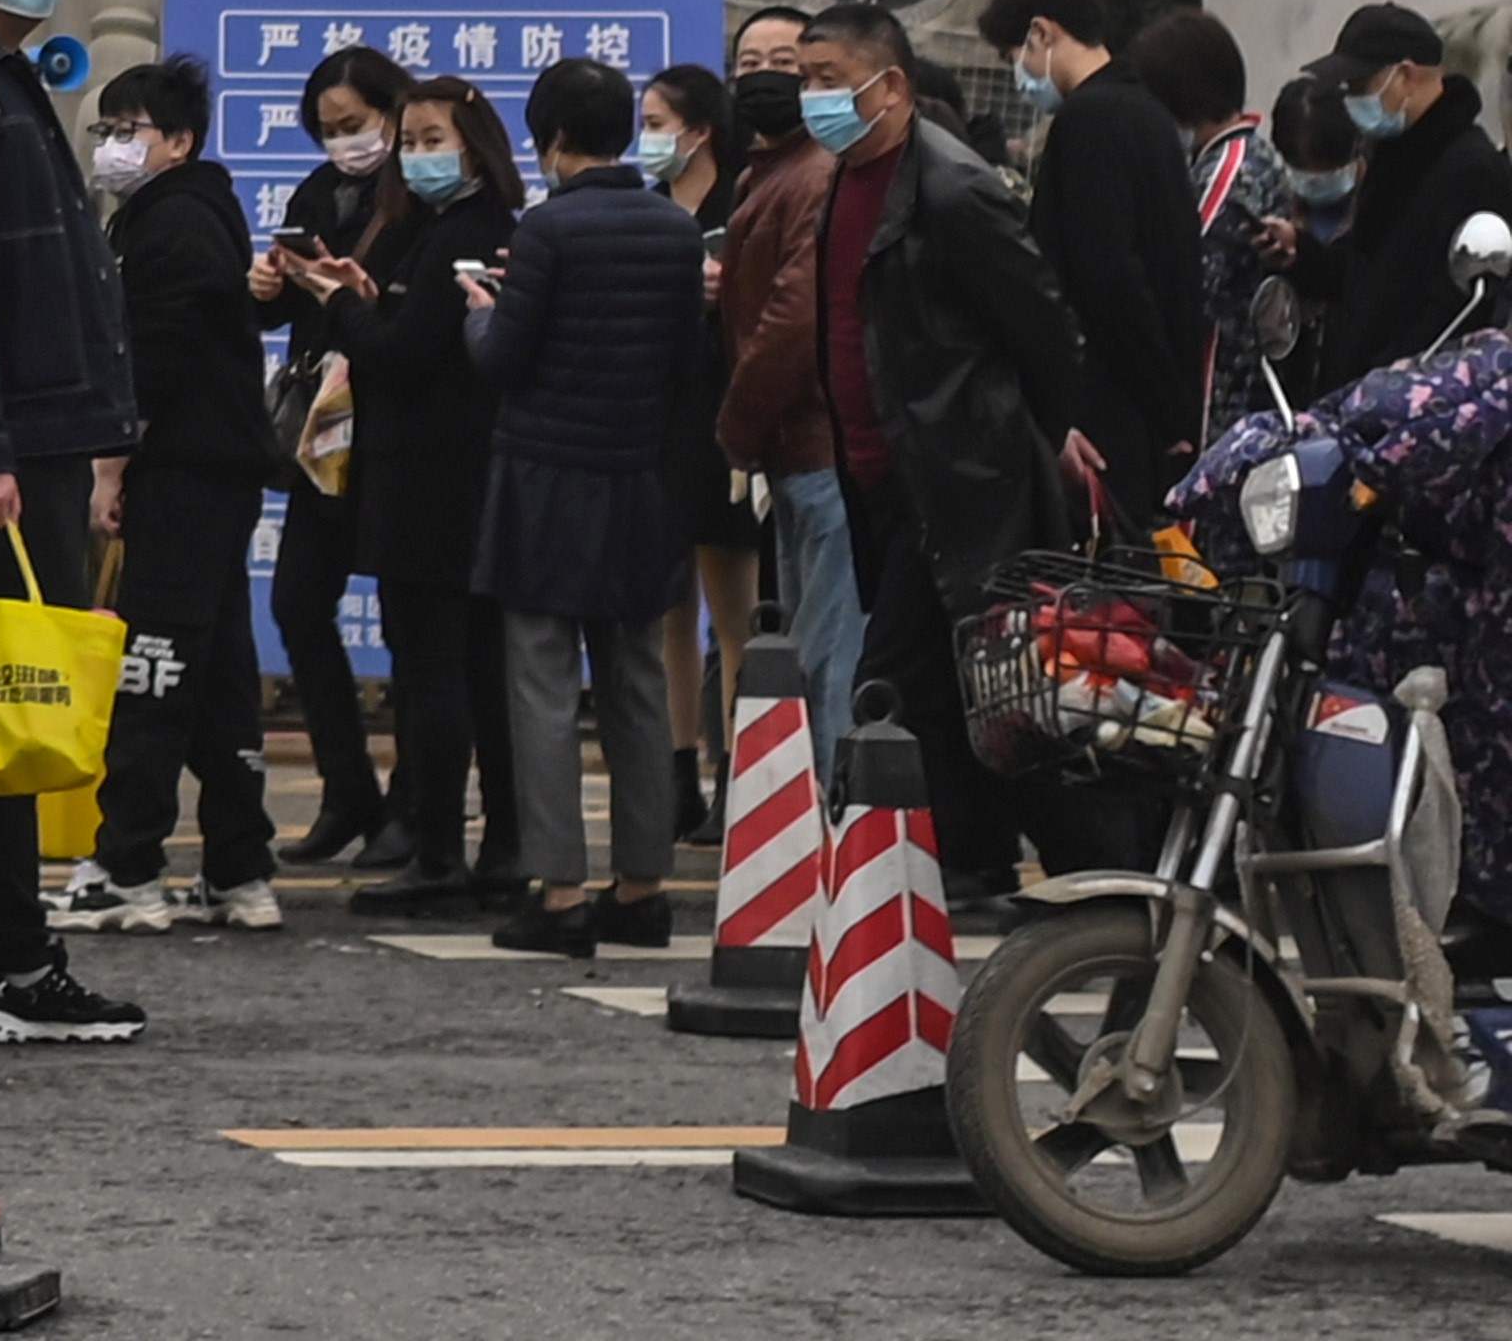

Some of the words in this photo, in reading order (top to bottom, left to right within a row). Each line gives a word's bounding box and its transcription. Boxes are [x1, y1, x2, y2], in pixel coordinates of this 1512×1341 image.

[258, 21, 631, 69] 严格疫情防控
